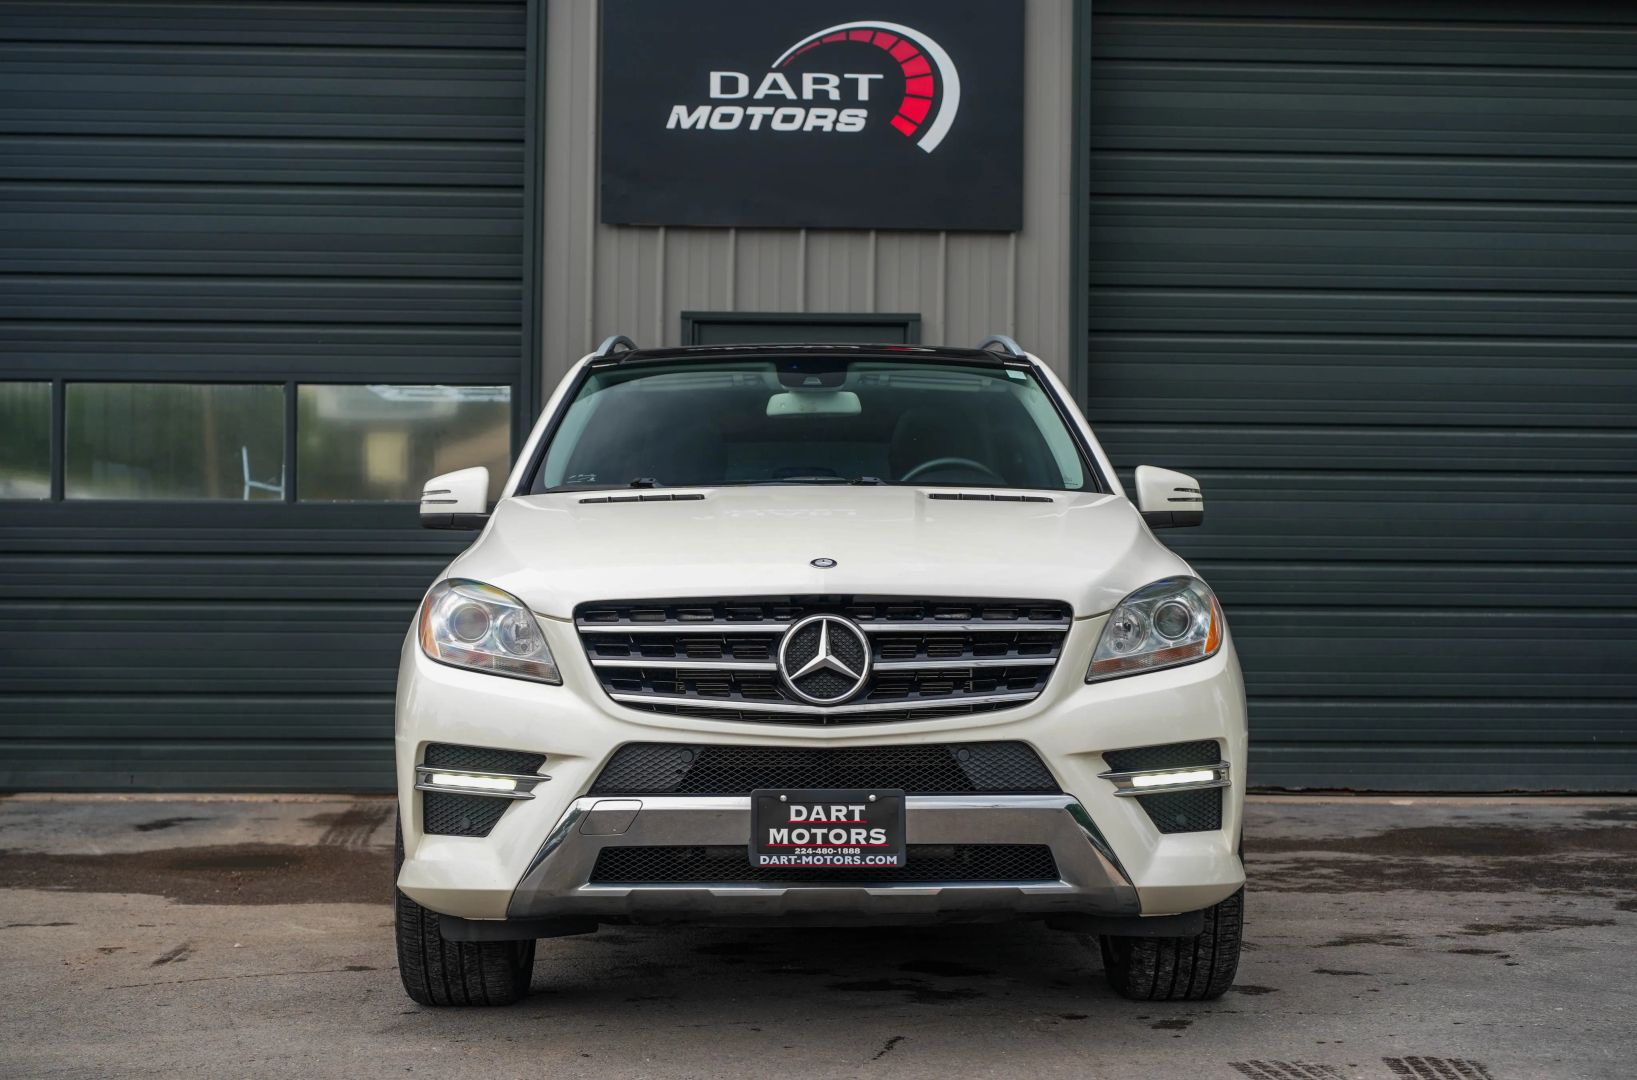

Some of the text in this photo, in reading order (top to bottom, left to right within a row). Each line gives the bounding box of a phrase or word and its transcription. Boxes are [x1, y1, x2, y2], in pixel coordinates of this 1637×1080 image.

[709, 71, 884, 101] DART
[666, 105, 868, 132] MOTORS
[789, 805, 866, 822] DART
[769, 828, 887, 845] MOTORS
[760, 855, 897, 865] DART-MOTORS.COM
